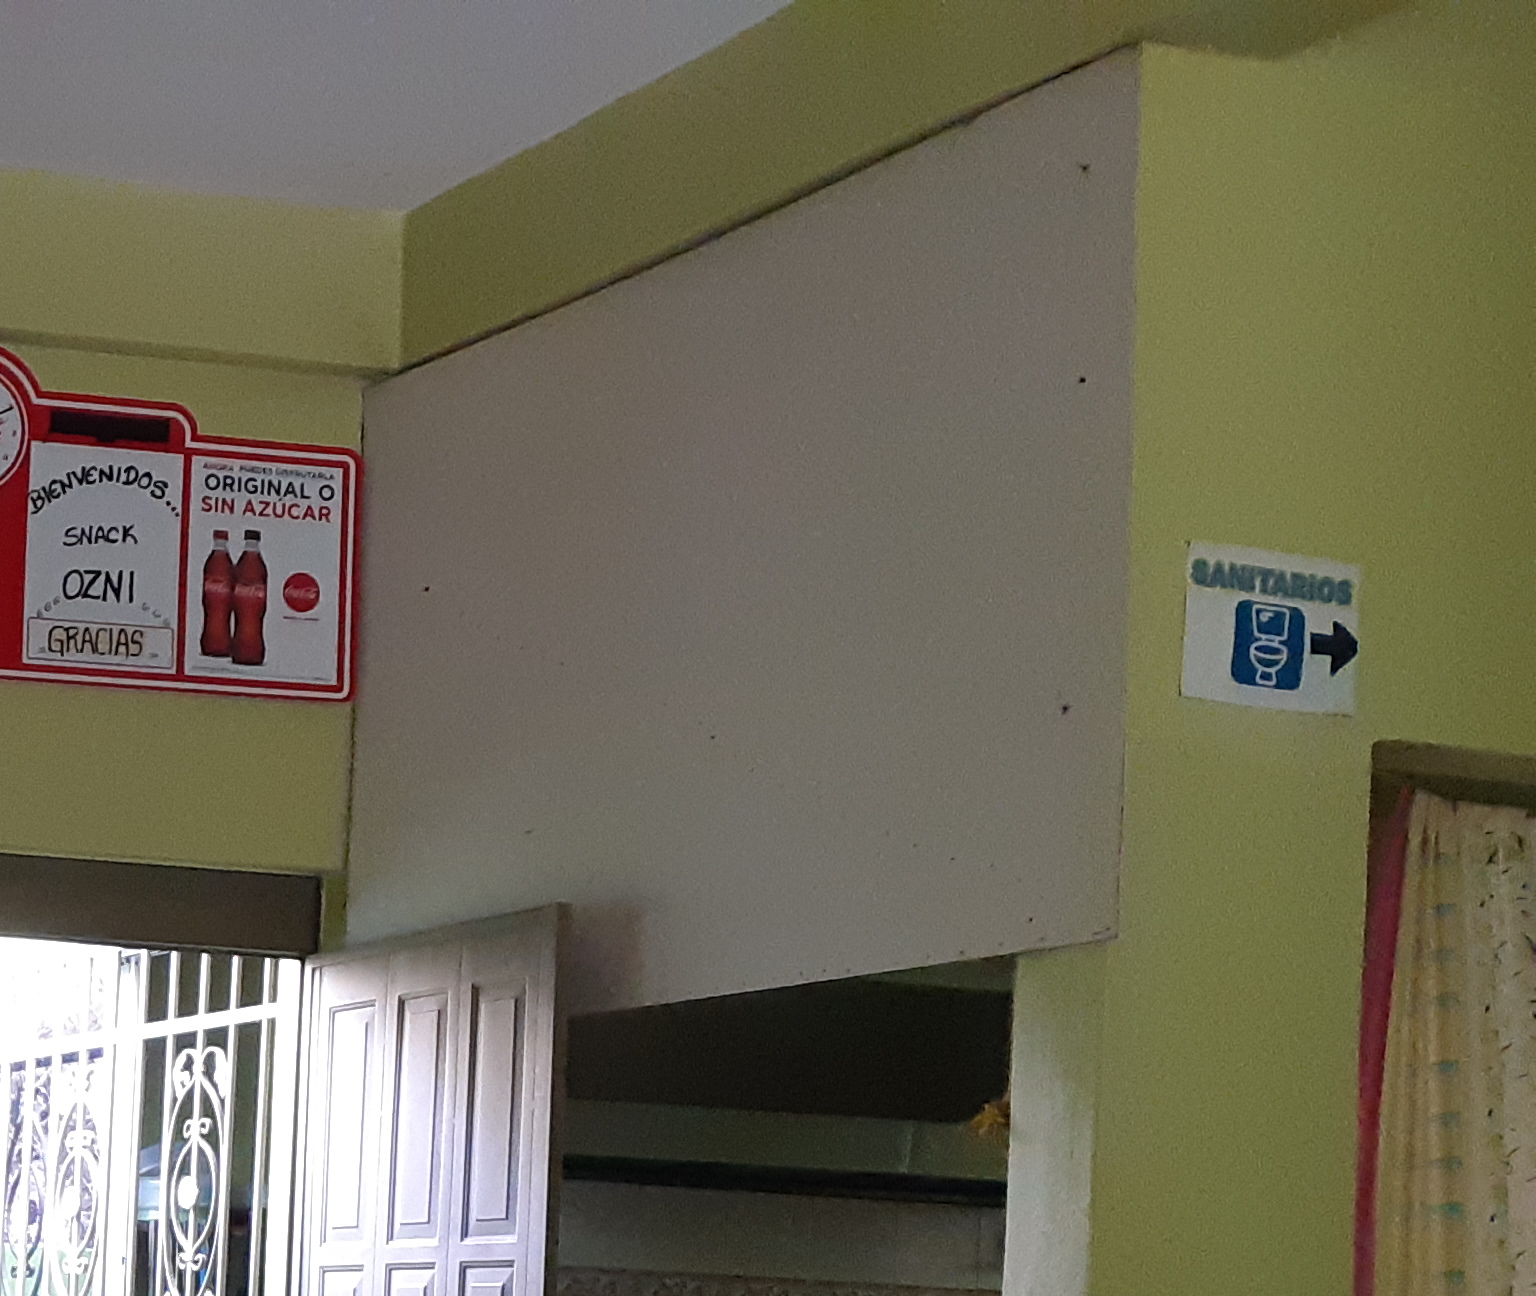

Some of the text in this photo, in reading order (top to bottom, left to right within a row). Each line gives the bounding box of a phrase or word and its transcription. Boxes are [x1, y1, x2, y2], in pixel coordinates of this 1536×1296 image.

[205, 473, 335, 501] ORIGINAL O
[201, 495, 331, 523] SIN AZÚCAR
[62, 524, 139, 547] SNACK
[62, 569, 136, 604] OZNI
[1190, 557, 1353, 606] SANITARIOS
[47, 625, 144, 660] GRACIAS
